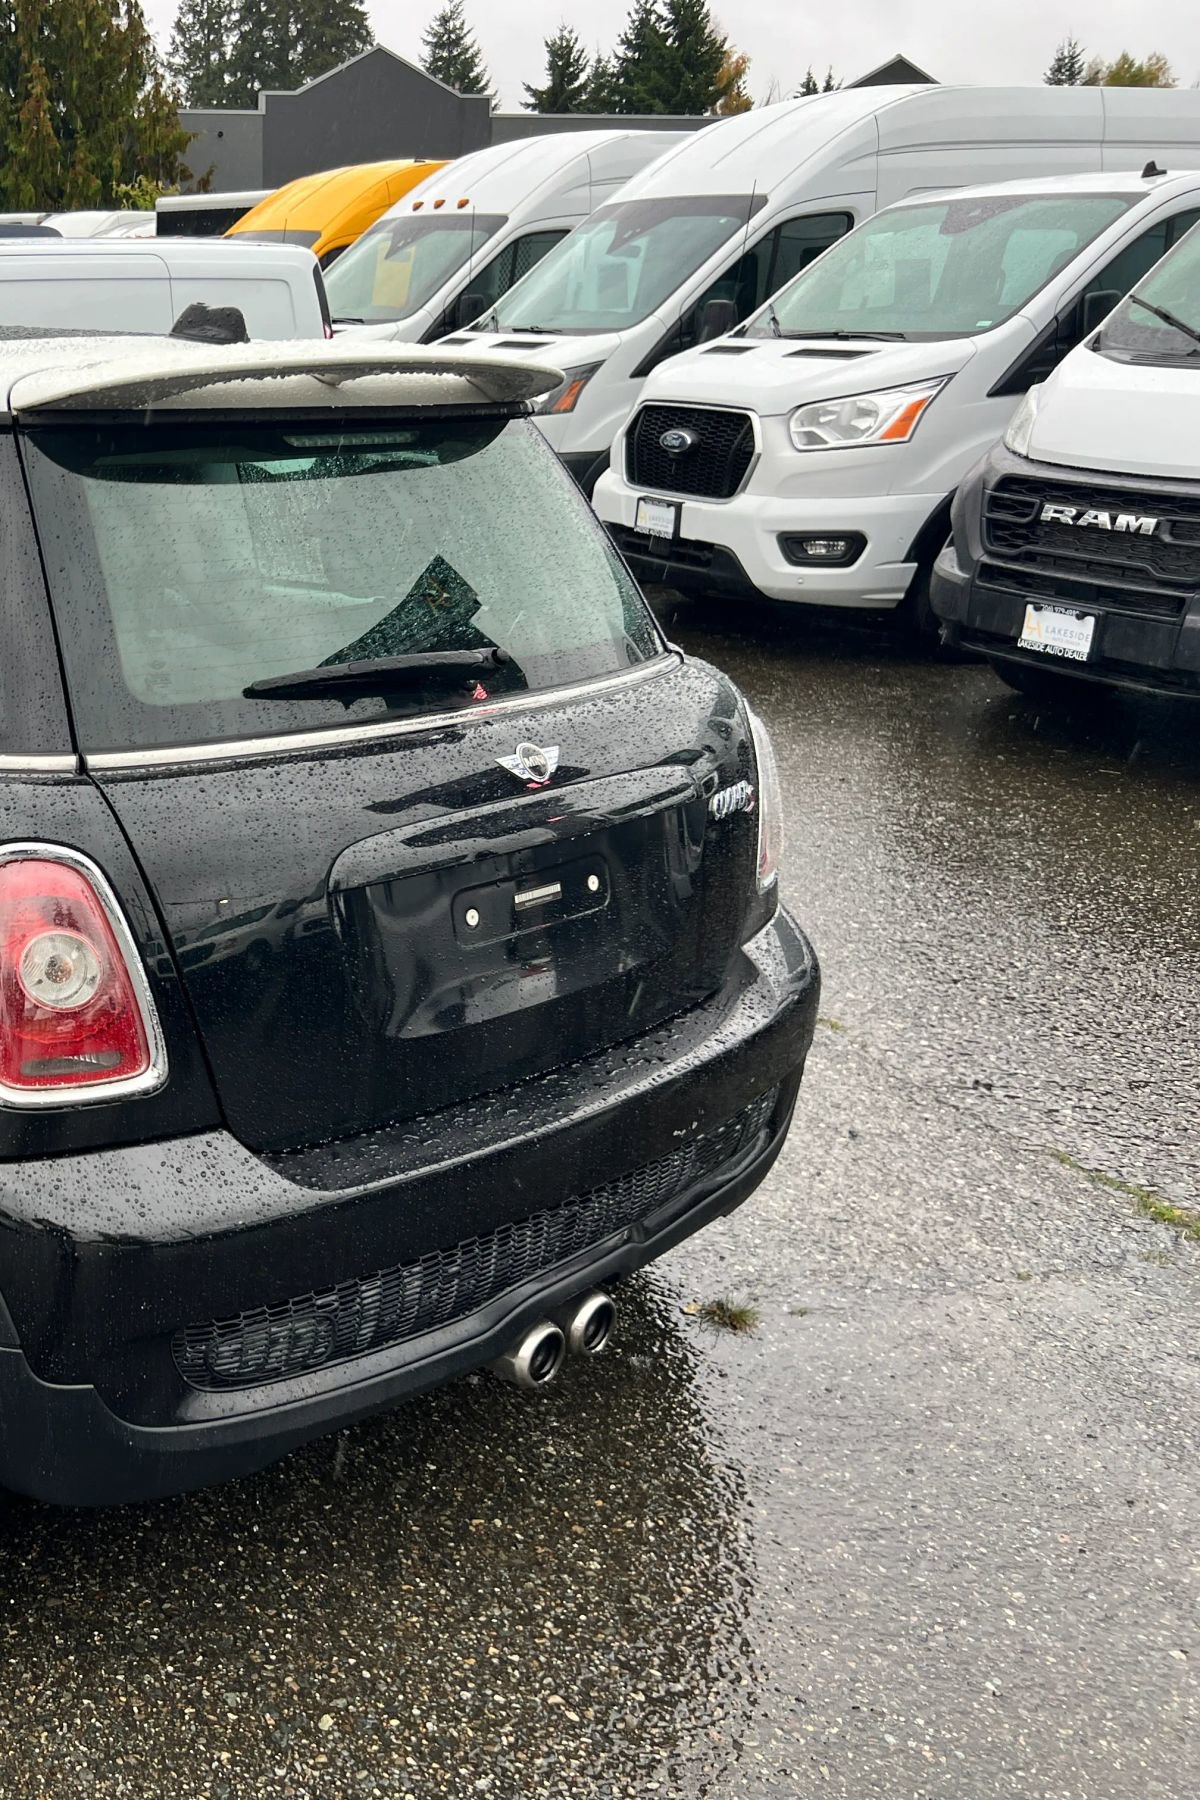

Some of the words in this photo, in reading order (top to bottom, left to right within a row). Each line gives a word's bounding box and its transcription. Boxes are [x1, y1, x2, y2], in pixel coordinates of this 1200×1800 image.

[664, 433, 682, 446] Ford
[1040, 504, 1158, 536] RAM
[1045, 626, 1091, 642] LAKESIDE
[1017, 638, 1044, 652] LAKESIDE
[1045, 645, 1064, 656] AUTO
[1064, 649, 1088, 662] DEALER
[523, 754, 546, 768] MINI
